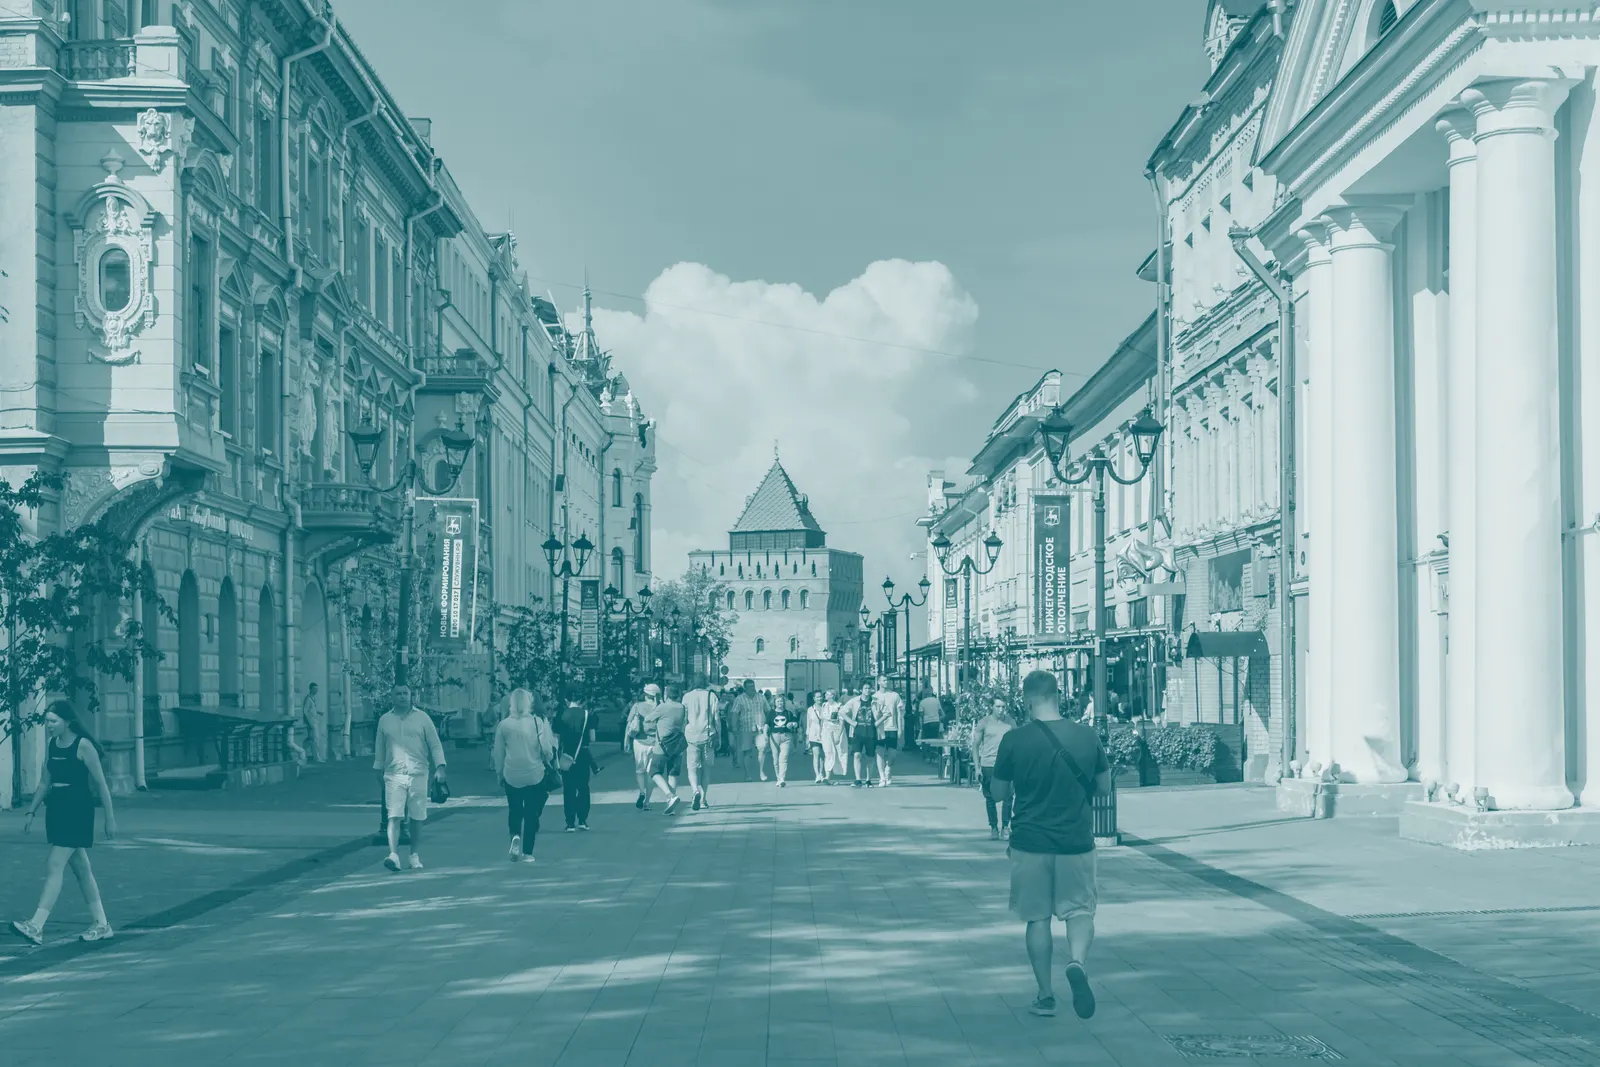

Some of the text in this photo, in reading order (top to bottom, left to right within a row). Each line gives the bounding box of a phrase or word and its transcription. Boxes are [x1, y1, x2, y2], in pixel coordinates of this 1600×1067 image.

[440, 538, 451, 638] НОВЫЕ ФОРМИРОВАНИЯ
[1045, 536, 1055, 634] НИЖЕГОРОДСКОЕ
[1057, 566, 1067, 634] ОПОЛЧЕНИЕ
